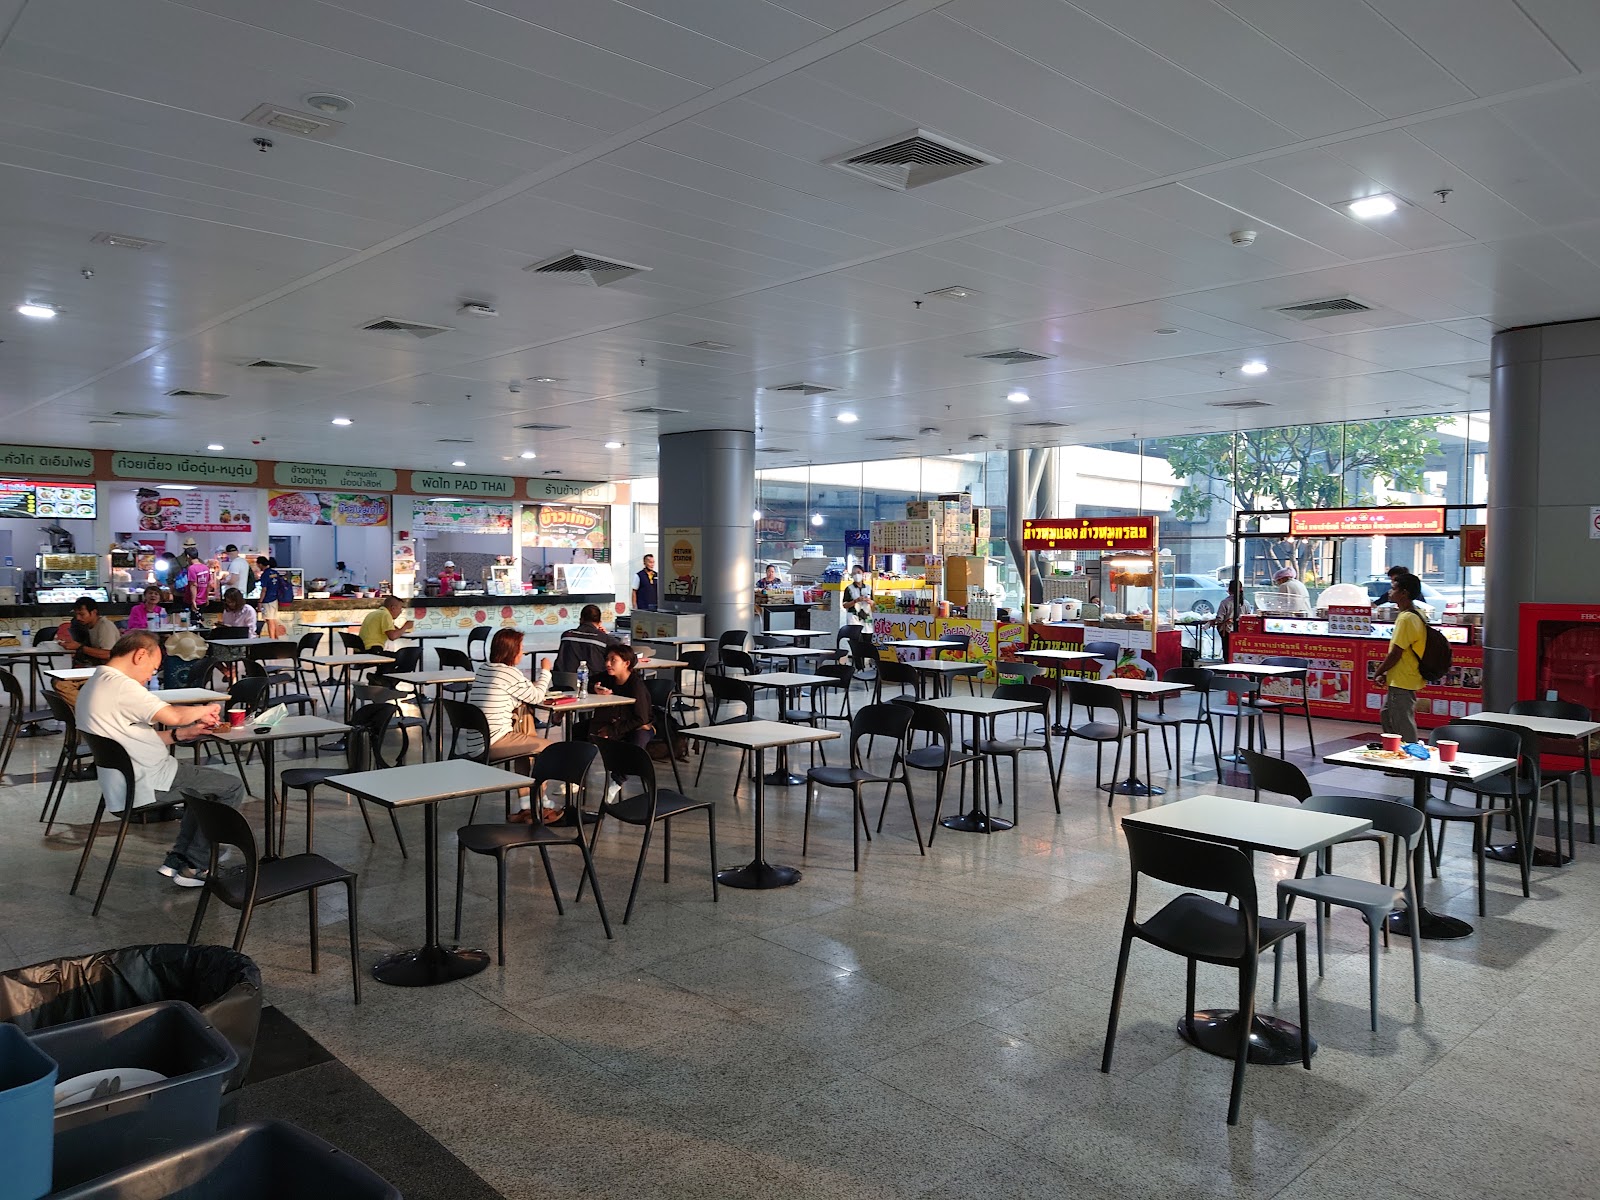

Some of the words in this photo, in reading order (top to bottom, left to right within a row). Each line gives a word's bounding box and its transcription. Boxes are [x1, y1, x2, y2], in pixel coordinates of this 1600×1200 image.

[118, 456, 172, 472] ก๋วยเตี๋ยว
[177, 459, 253, 480] เนื้อตุ๋น-หมูตุ๋น
[290, 465, 327, 479] ข้าวขาหมู
[421, 477, 451, 489] ผัดไท
[455, 480, 478, 491] PAD
[481, 481, 507, 492] THAI
[541, 507, 595, 527] ข้าวแกง
[1024, 521, 1078, 547] ข้าวหมูแดง
[1079, 521, 1147, 546] ข้าวหมูกรอบ
[874, 620, 892, 634] BIG
